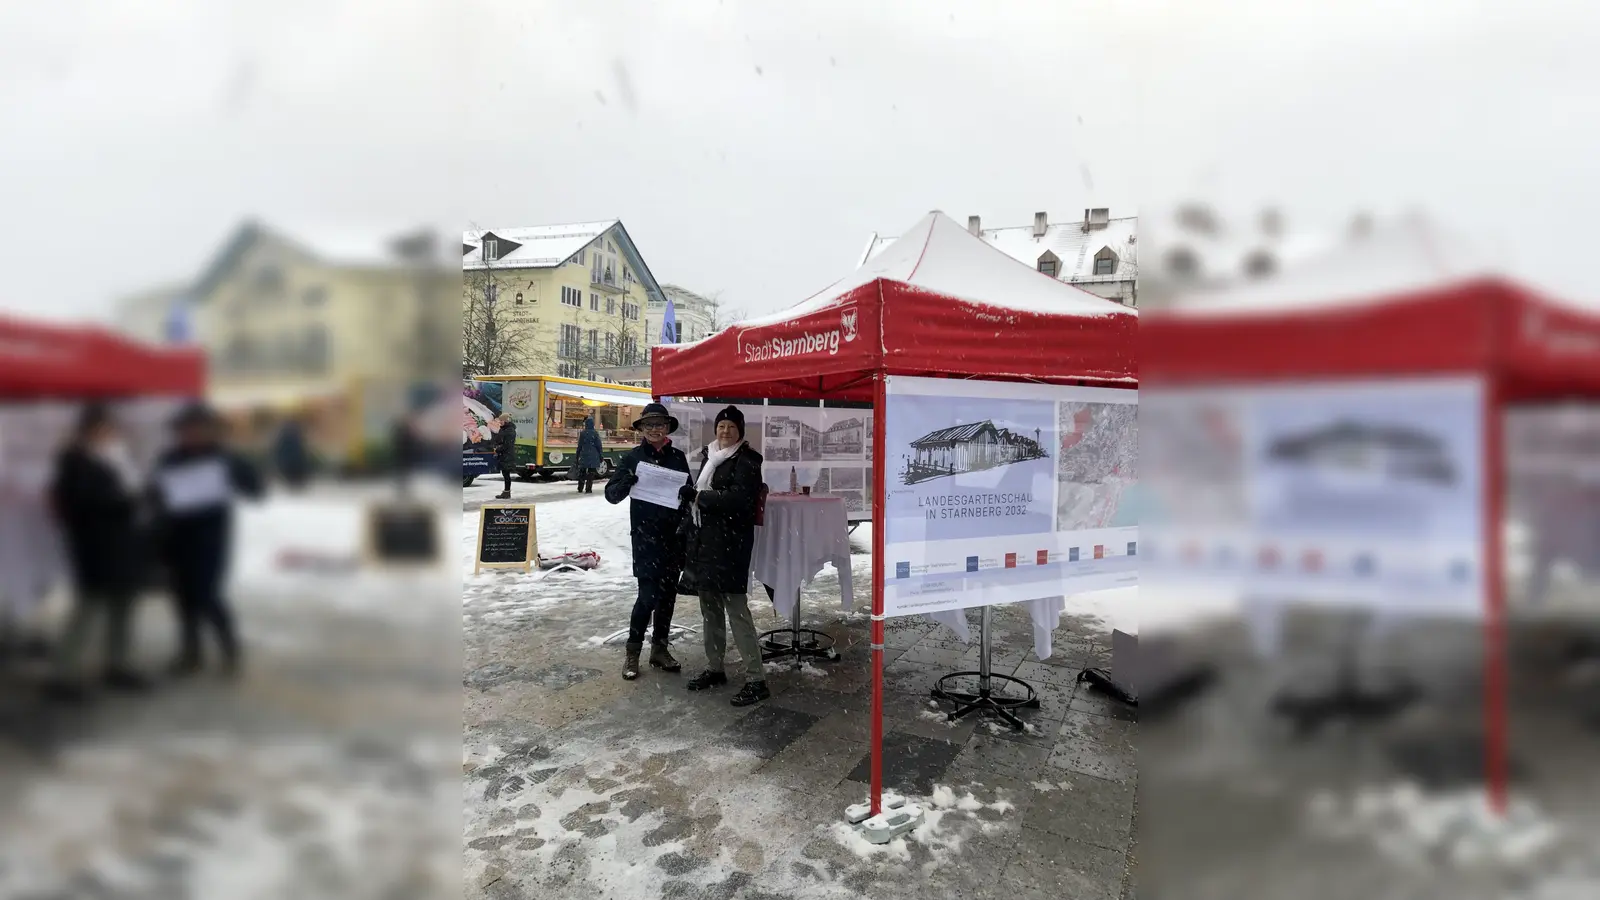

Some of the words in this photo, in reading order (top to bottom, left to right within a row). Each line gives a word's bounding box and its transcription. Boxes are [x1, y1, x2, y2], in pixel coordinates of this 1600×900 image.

[918, 493, 1033, 507] LANDESGARTENSCHAU
[925, 509, 937, 520] IN
[941, 506, 1002, 519] STARNBERG
[1005, 505, 1027, 516] 2032
